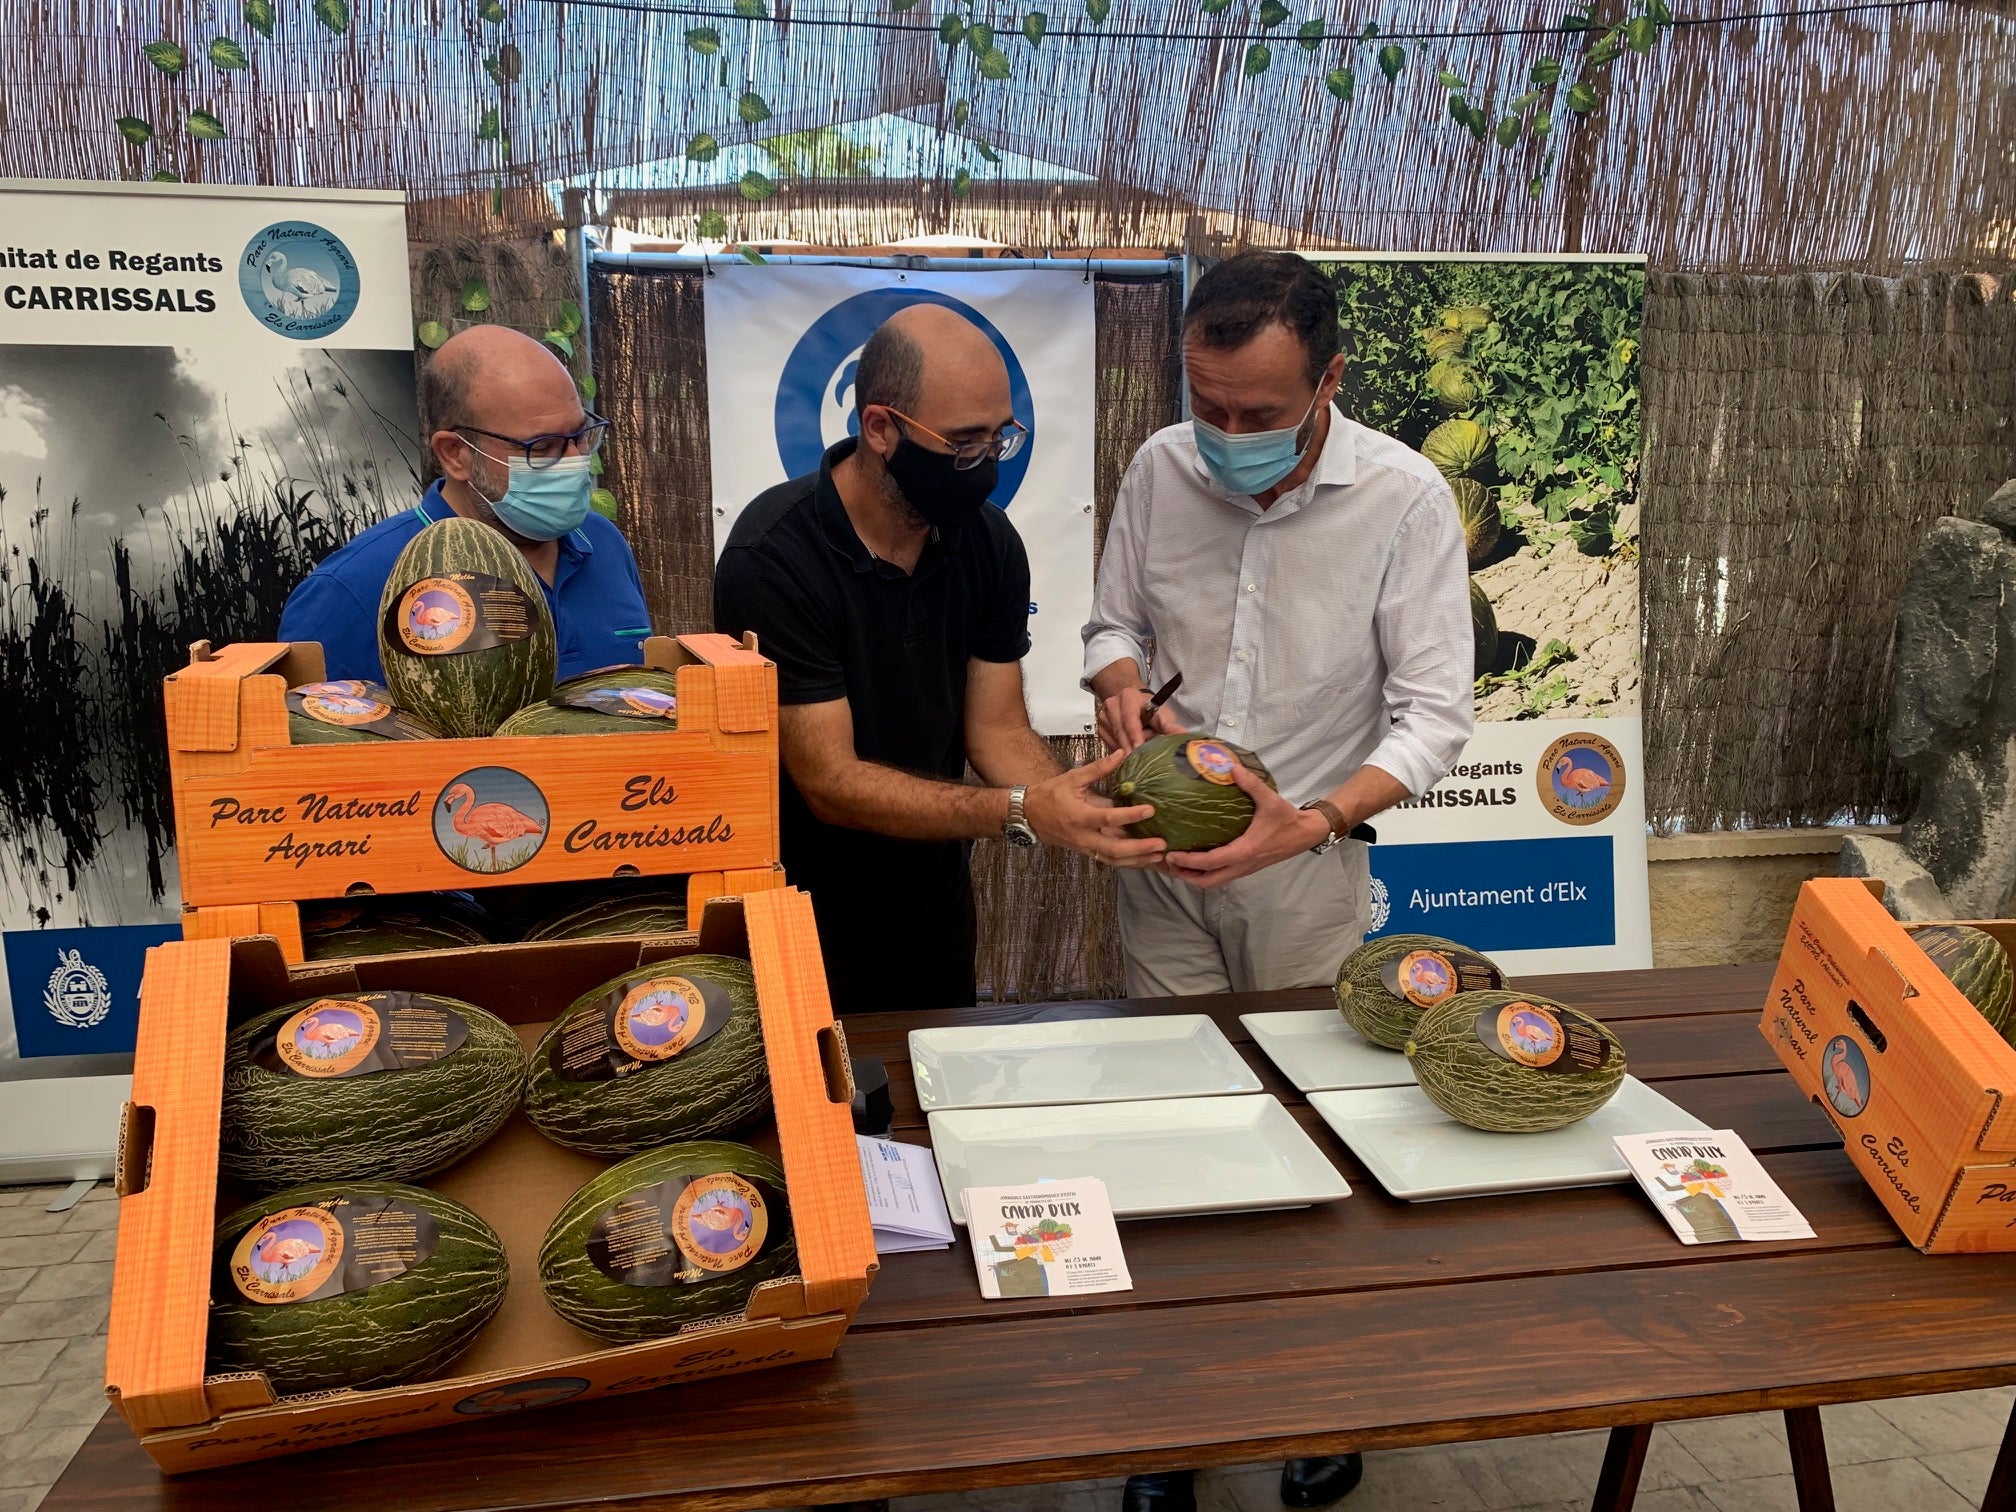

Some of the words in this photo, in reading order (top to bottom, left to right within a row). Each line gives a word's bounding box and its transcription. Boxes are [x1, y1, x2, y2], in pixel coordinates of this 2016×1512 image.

[65, 249, 100, 270] de
[108, 250, 223, 276] Regants
[247, 240, 267, 268] Parc
[268, 228, 318, 240] Natural
[320, 238, 354, 270] Agrari
[4, 285, 216, 313] CARRISSALS
[265, 312, 283, 328] Els
[285, 313, 342, 331] Carrissals
[409, 583, 429, 599] Parc
[1543, 748, 1559, 770] Parc
[1559, 737, 1598, 748] Natural
[1598, 744, 1622, 769] Agrari
[210, 797, 286, 829] Parc
[297, 790, 422, 825] Natural
[620, 775, 679, 813] Els
[1553, 805, 1566, 817] Els
[1567, 803, 1612, 819] Carrissals
[563, 814, 736, 855] Carrissals
[264, 833, 373, 870] Agrari
[1409, 884, 1535, 914] Ajuntament
[1540, 881, 1588, 903] d'Elx
[304, 1002, 330, 1016] Parc
[336, 1002, 373, 1015] Natural
[1792, 978, 1816, 1016] Parc
[1780, 988, 1819, 1045] Natural
[281, 1041, 293, 1056] Els
[288, 1053, 336, 1074] Carrissals
[1887, 1136, 1909, 1167] Els
[1861, 1133, 1921, 1215] Carrissals
[259, 1212, 288, 1230] Parc
[294, 1209, 334, 1230] Natural
[1001, 1204, 1044, 1219] CAMP
[684, 1243, 724, 1269] Natural
[728, 1244, 753, 1264] Parc
[236, 1265, 250, 1283] Els
[245, 1279, 296, 1300] Carrissals
[606, 1349, 795, 1390] Carrissals
[673, 1348, 736, 1368] Els
[187, 1432, 276, 1451] Parc
[293, 1402, 441, 1434] Natural
[259, 1424, 382, 1451] Agrari
